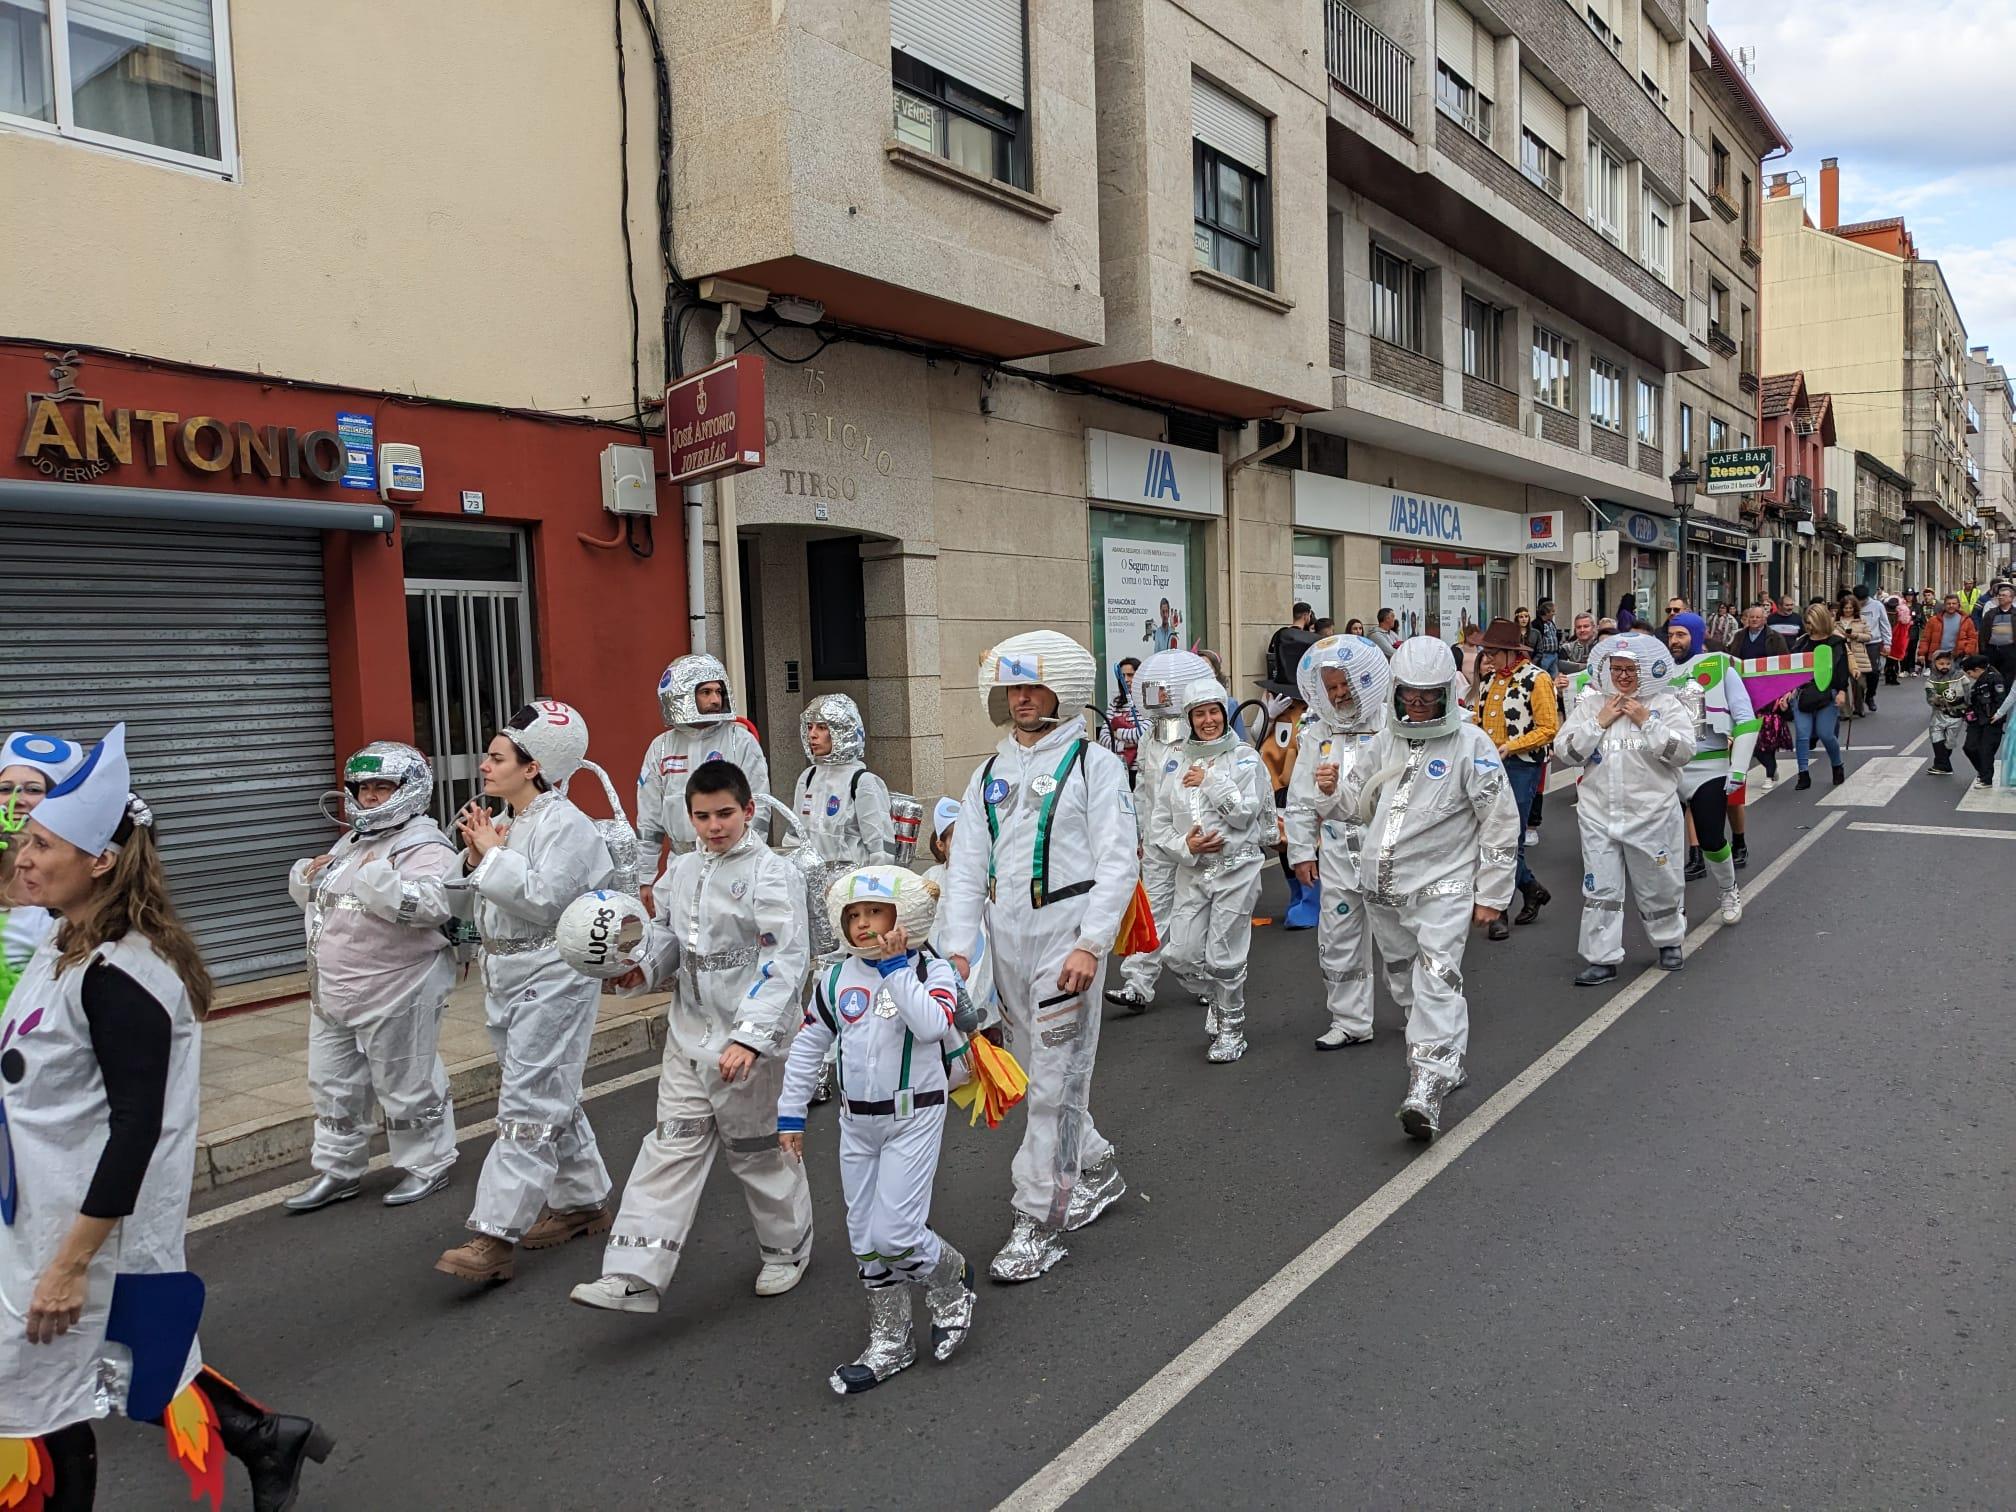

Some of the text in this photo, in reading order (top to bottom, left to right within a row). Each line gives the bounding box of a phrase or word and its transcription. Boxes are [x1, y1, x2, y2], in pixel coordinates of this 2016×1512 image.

[901, 99, 931, 125] VENDE
[1195, 236, 1209, 252] ENDE
[804, 368, 826, 396] 75
[695, 411, 736, 443] ANTONIO
[18, 399, 348, 482] ANTONIO
[766, 411, 893, 477] DIFICIO
[32, 457, 111, 481] JOYERIAS
[1709, 464, 1760, 478] Resero
[780, 468, 857, 501] TIRSO
[466, 500, 480, 509] 73
[817, 508, 826, 517] 75
[1121, 559, 1127, 569] O
[1128, 559, 1149, 574] Seguro
[1152, 574, 1169, 590] Fogar
[583, 907, 616, 965] LUCAS
